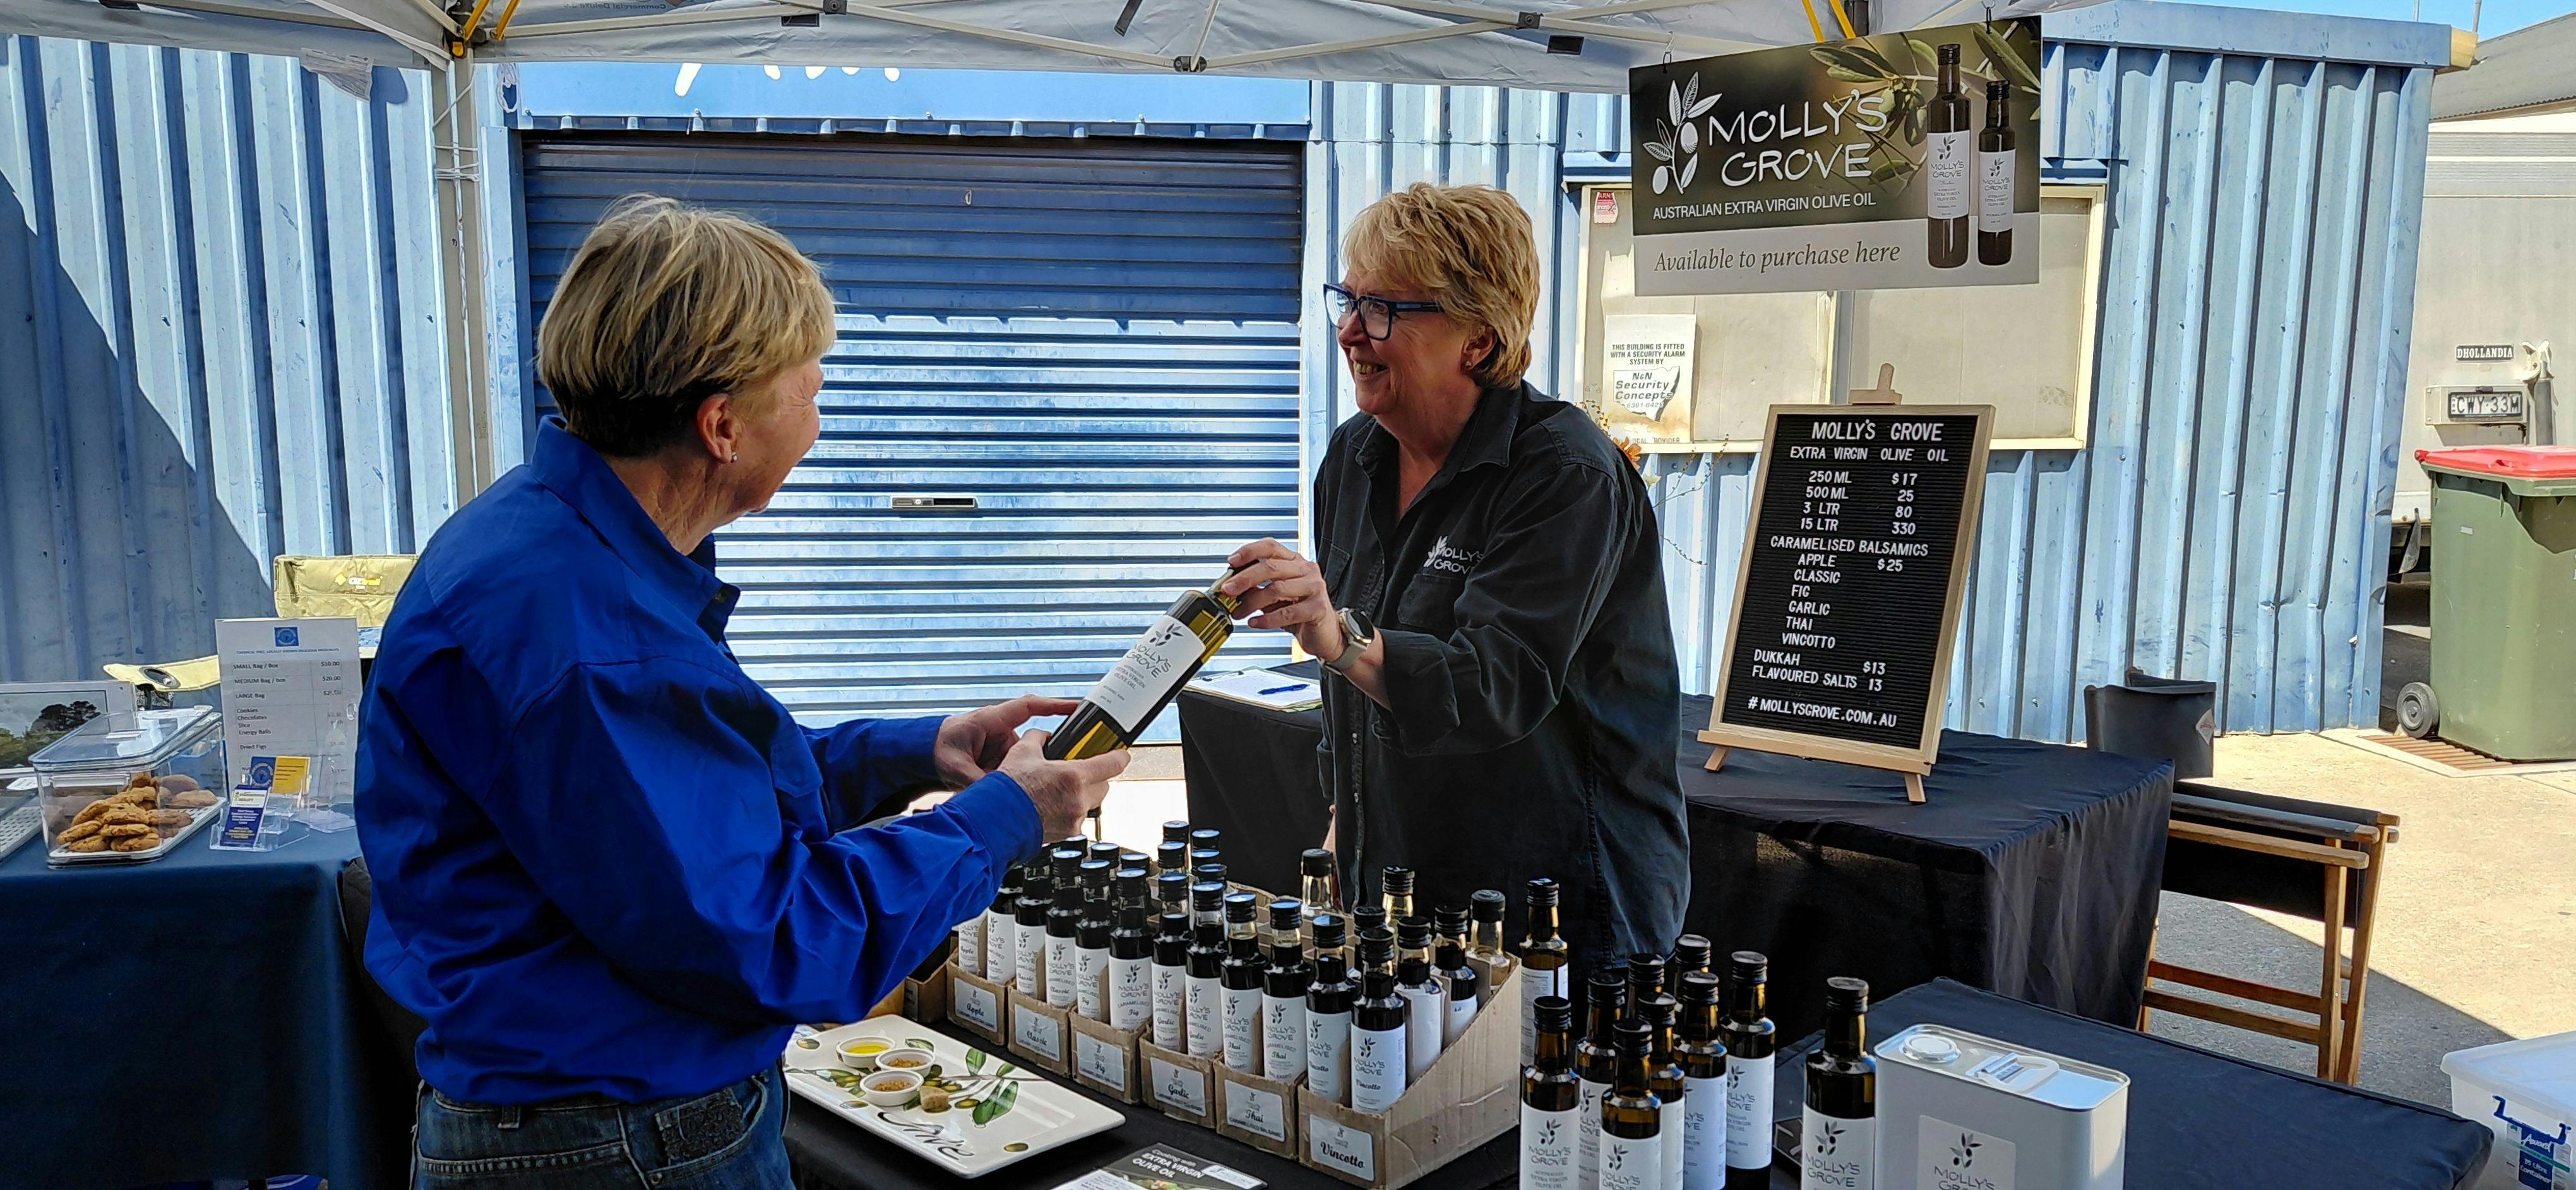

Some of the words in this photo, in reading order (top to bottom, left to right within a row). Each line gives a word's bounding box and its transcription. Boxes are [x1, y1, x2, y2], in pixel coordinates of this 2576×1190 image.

[1709, 89, 1887, 146] MOLLY'S
[1721, 143, 1872, 186] GROVE
[1931, 160, 1964, 170] MOLLY'S
[1653, 203, 1722, 220] AUSTRALIAN
[1724, 201, 1763, 215] EXTRA
[1766, 196, 1809, 213] VIRGIN
[1811, 195, 1850, 210] OLIVE
[1853, 192, 1876, 207] OIL
[1654, 244, 1734, 272] Available
[1739, 248, 1756, 267] to
[1760, 243, 1850, 273] purchase
[1855, 241, 1901, 263] here
[2457, 347, 2513, 358] DHOLLANDIA
[1616, 380, 1669, 391] Security
[1615, 391, 1673, 402] Concepts
[1812, 419, 1876, 441] MOLLY'S
[1890, 423, 1944, 442] GROVE
[1790, 446, 1827, 460] EXTRA
[1834, 447, 1868, 460] VIRGIN
[1880, 448, 1914, 461] OLIVE
[1927, 449, 1949, 462] OIL
[1809, 470, 1832, 483] 250
[1832, 471, 1852, 483] ML
[1806, 486, 1829, 499] 500
[1830, 487, 1849, 500] ML
[1897, 490, 1914, 502] 25
[1803, 502, 1811, 514] 3
[1818, 502, 1840, 516] LTR
[1895, 505, 1912, 519] 80
[1800, 517, 1813, 531] 15
[1816, 519, 1839, 532] LTR
[1892, 522, 1916, 535] 330
[1770, 536, 1856, 552] CARAMELISED
[1859, 540, 1929, 556] BALSAMICS
[1434, 559, 1475, 574] GROV
[1798, 553, 1836, 568] APPLE
[1877, 558, 1904, 572] $25
[1794, 569, 1841, 584] CLASSIC
[1791, 584, 1810, 598] FIG
[1789, 601, 1830, 616] GARLIC
[1786, 616, 1813, 631] THAI
[1782, 633, 1835, 649] VINCOTTO
[1754, 649, 1801, 666] DUKKAH
[1863, 661, 1886, 675] $13
[1752, 665, 1818, 685] FLAVOURED
[1823, 673, 1857, 689] SALTS
[1868, 678, 1883, 692] 13
[1118, 983, 1149, 992] MOLLY'S
[967, 1003, 984, 1017] Apple
[1027, 1030, 1047, 1046] Classic
[1268, 1032, 1293, 1041] GROVE
[1272, 1051, 1286, 1059] Thai
[1095, 1061, 1106, 1074] Fig
[1356, 1064, 1383, 1076] GROVE
[1168, 1084, 1190, 1099] Garlic
[1245, 1109, 1264, 1123] Thai
[1320, 1141, 1364, 1169] Vincotto
[1528, 1145, 1571, 1157] MOLLY'S
[1132, 1158, 1161, 1172] OLIVE
[1159, 1169, 1176, 1178] OIL
[1142, 1153, 1170, 1167] EXTRA
[1172, 1163, 1205, 1179] VIRGIN
[1531, 1155, 1568, 1166] GROVE
[1806, 1153, 1861, 1175] MOLLY'S
[1807, 1167, 1856, 1187] GROVE
